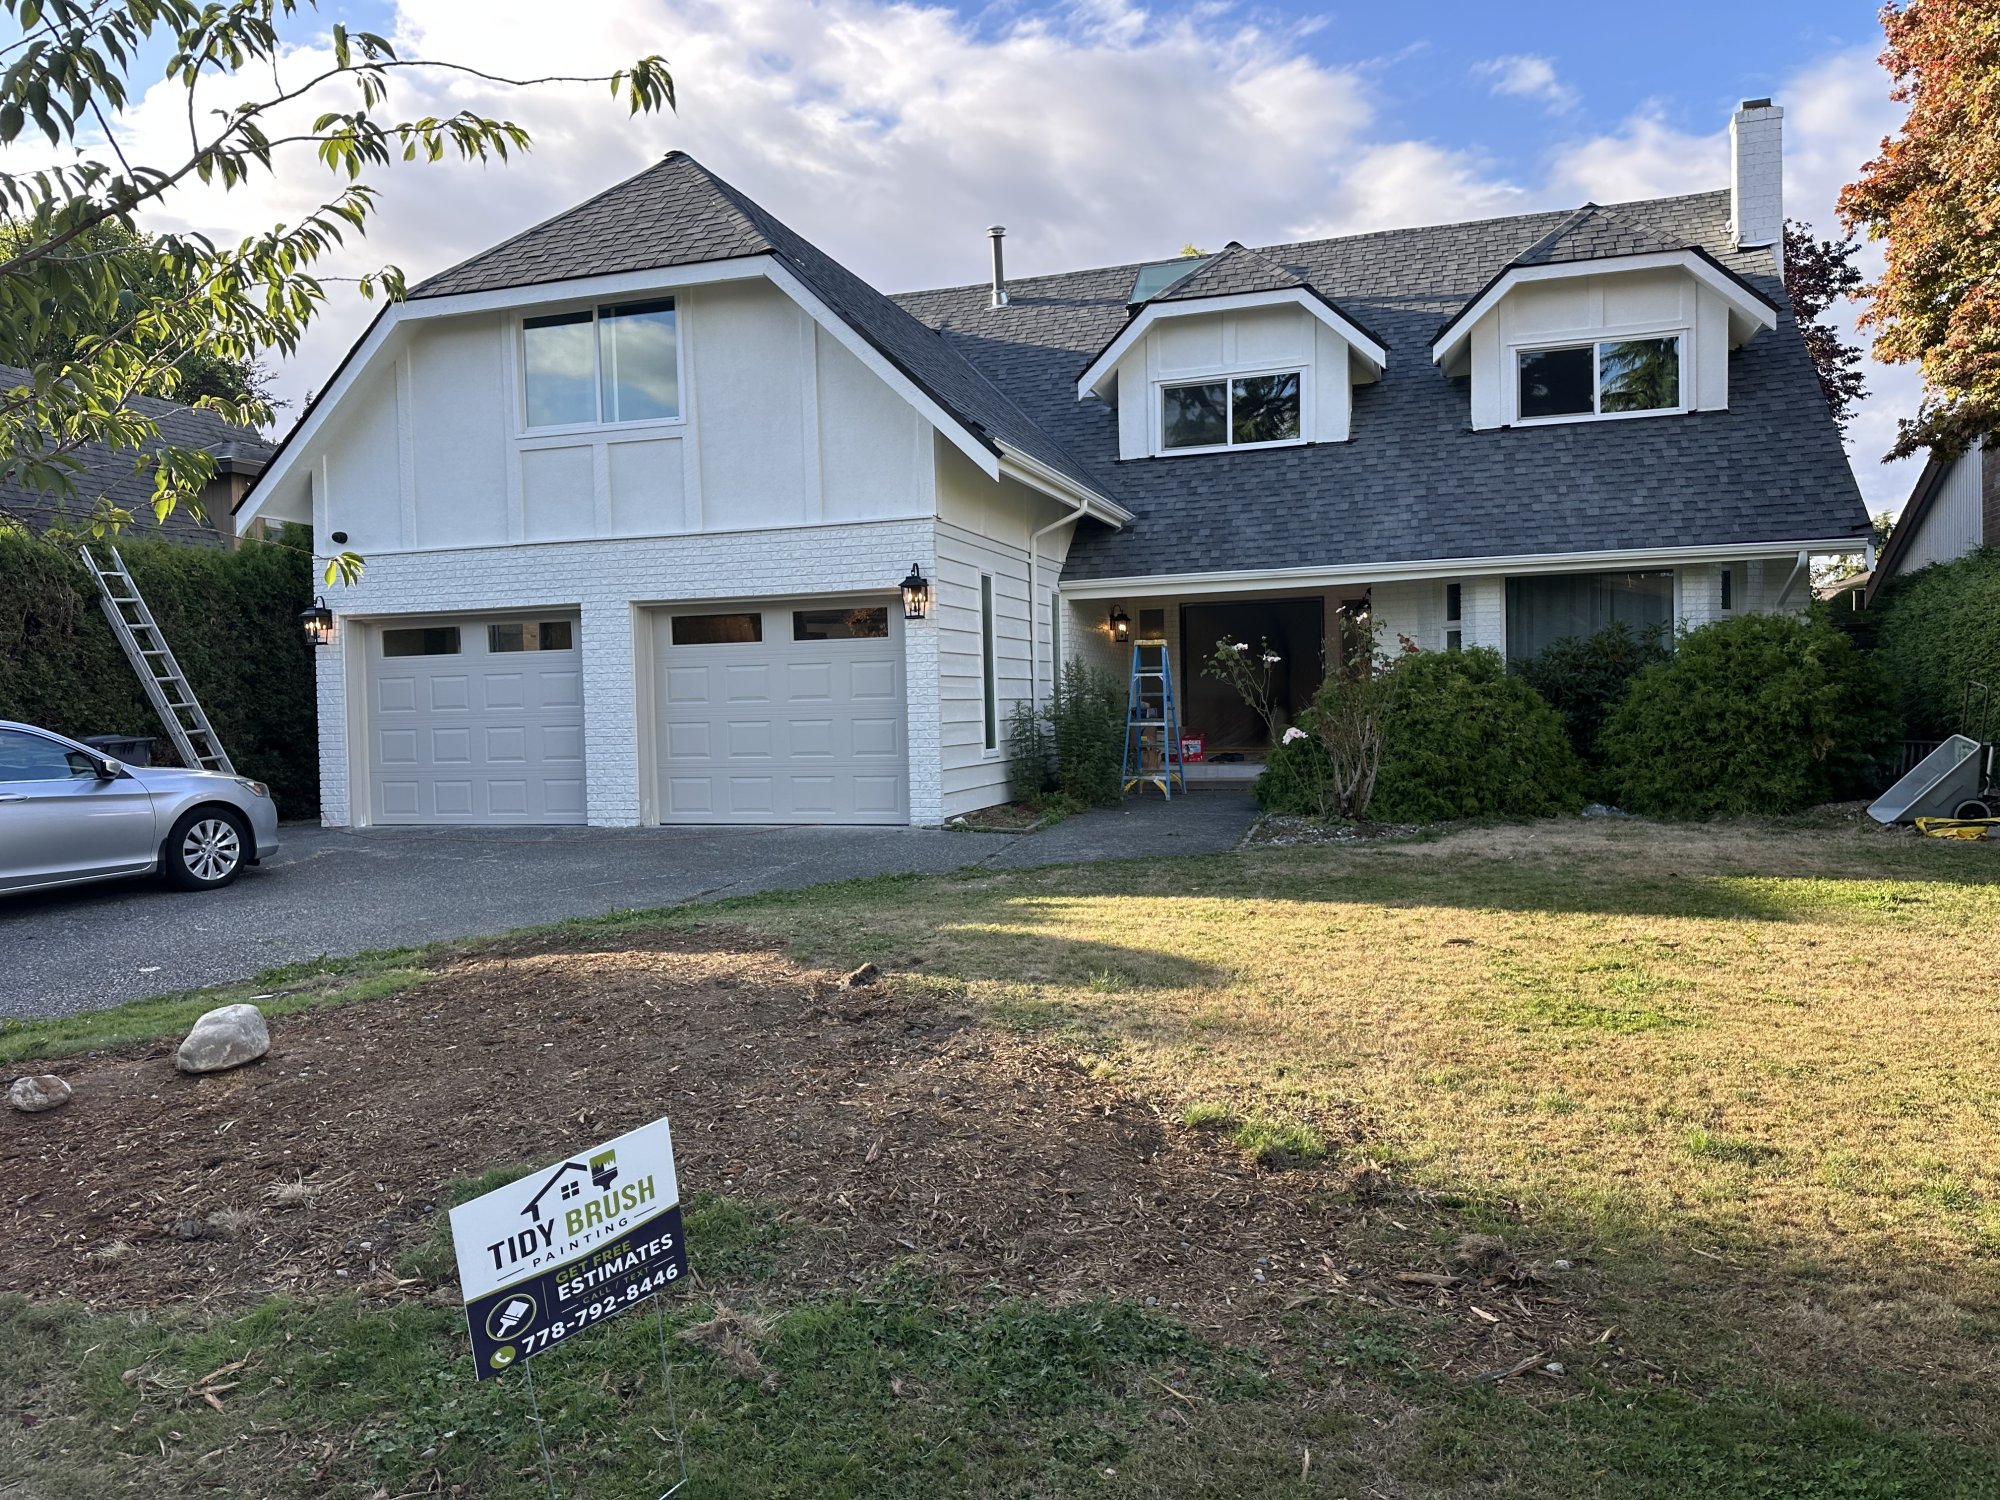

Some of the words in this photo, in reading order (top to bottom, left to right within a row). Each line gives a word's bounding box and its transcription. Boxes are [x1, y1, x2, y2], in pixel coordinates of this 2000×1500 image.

[487, 1218, 554, 1270] TIDY
[565, 1175, 655, 1237] BRUSH
[533, 1217, 628, 1268] PAINTING
[555, 1260, 588, 1284] GET
[593, 1240, 631, 1267] FREE
[557, 1233, 673, 1301] ESTIMATES
[582, 1287, 610, 1304] CALL
[624, 1266, 650, 1284] TEXT
[521, 1263, 678, 1354] 778-792-8446
